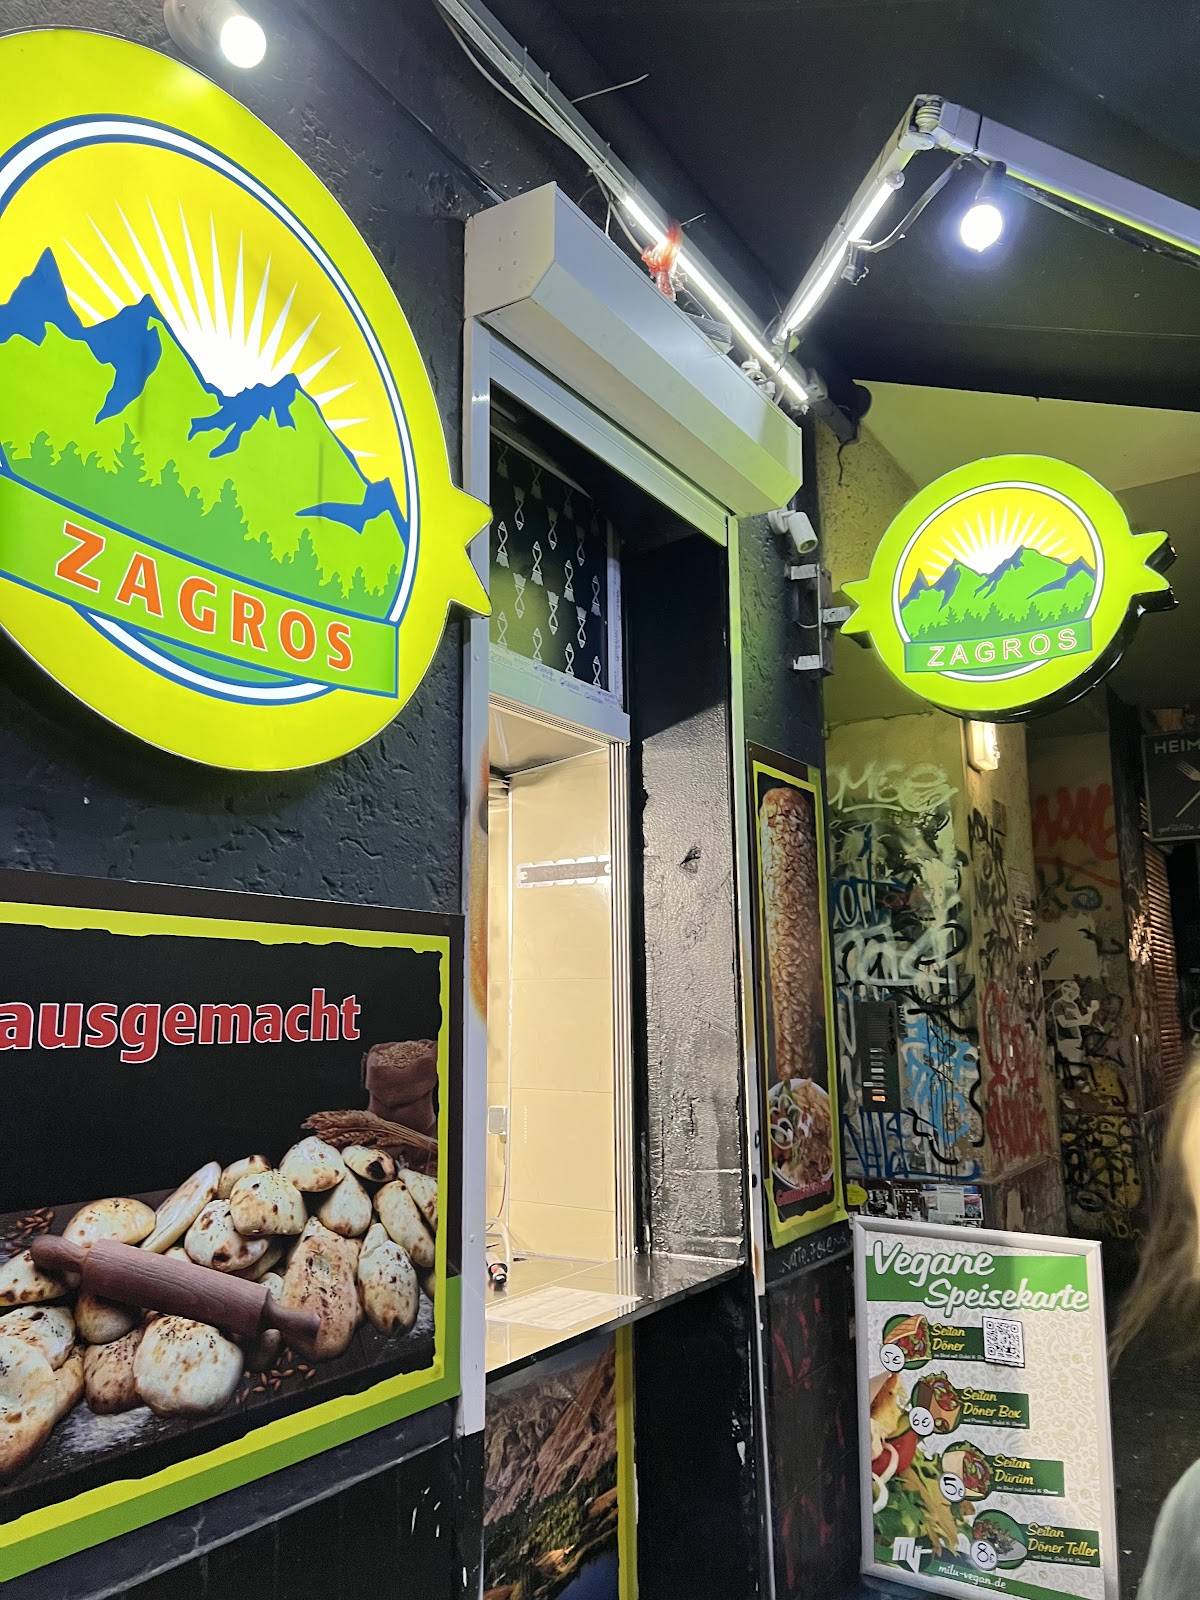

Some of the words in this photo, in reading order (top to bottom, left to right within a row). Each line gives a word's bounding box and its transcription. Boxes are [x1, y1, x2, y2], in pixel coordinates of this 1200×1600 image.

[55, 521, 354, 672] ZAGROS
[927, 628, 1078, 667] ZAGROS
[0, 988, 361, 1063] ausgemacht
[873, 1240, 996, 1287] Vegane
[924, 1278, 1090, 1318] Speisekarte
[931, 1323, 966, 1337] Seitan
[932, 1338, 965, 1351] Döner
[961, 1388, 997, 1402] Seitan
[962, 1402, 996, 1417] Döner
[998, 1405, 1022, 1419] Box
[993, 1455, 1031, 1470] Seitan
[1026, 1523, 1065, 1539] Seitan
[1027, 1538, 1064, 1554] Döner
[1065, 1541, 1099, 1558] Teller
[938, 1564, 1006, 1589] milu-vegan.de
